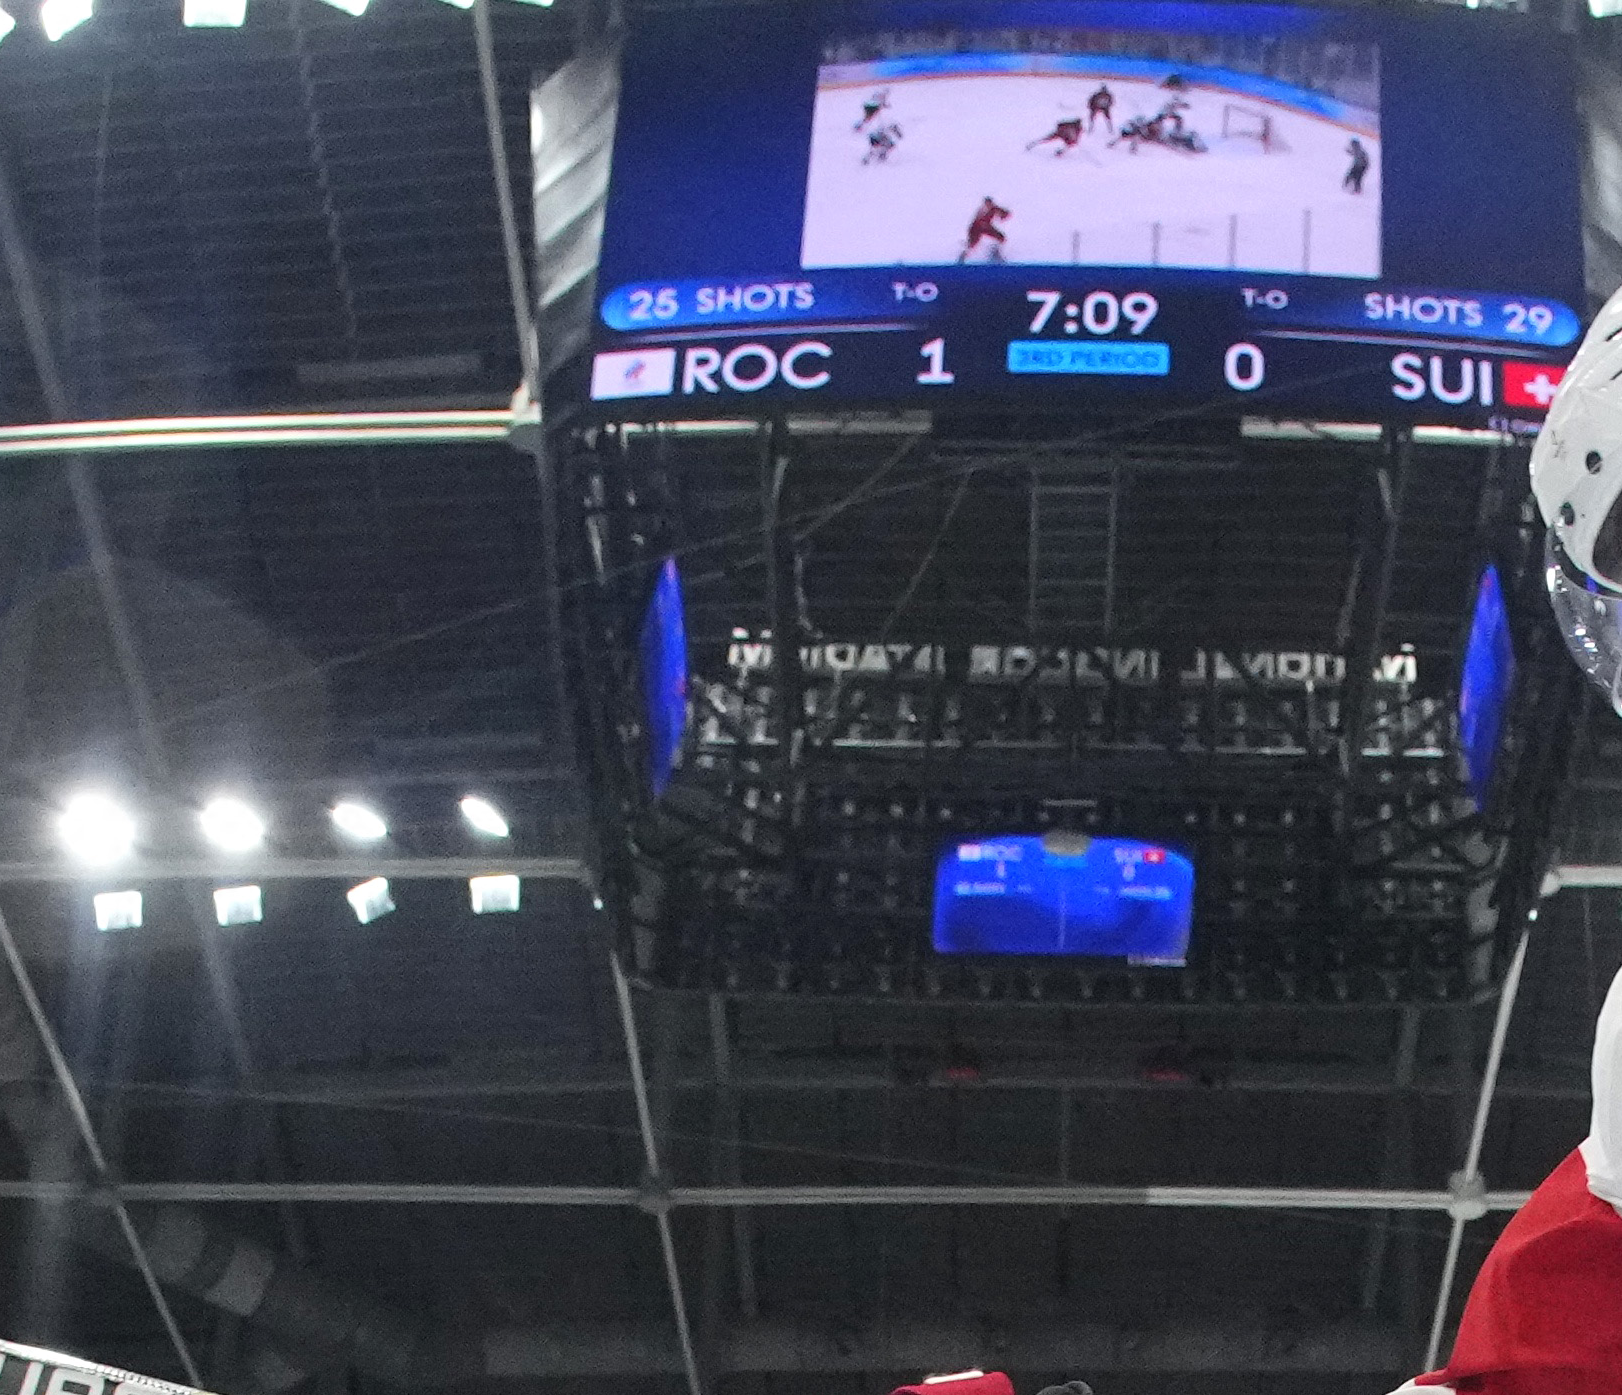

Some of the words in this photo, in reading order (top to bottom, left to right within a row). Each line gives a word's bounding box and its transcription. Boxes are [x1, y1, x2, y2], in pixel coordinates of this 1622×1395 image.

[628, 288, 677, 321] 25
[695, 282, 815, 316] SHOTS
[892, 281, 939, 302] T-O
[1026, 289, 1158, 336] 7:09
[1241, 287, 1289, 310] T-O
[1364, 292, 1484, 328] SHOTS
[1503, 302, 1553, 334] 29
[682, 341, 833, 395] ROC
[916, 338, 955, 385] 1
[1069, 349, 1160, 370] PERIOD
[1224, 341, 1265, 392] 0
[1390, 350, 1493, 407] SUI
